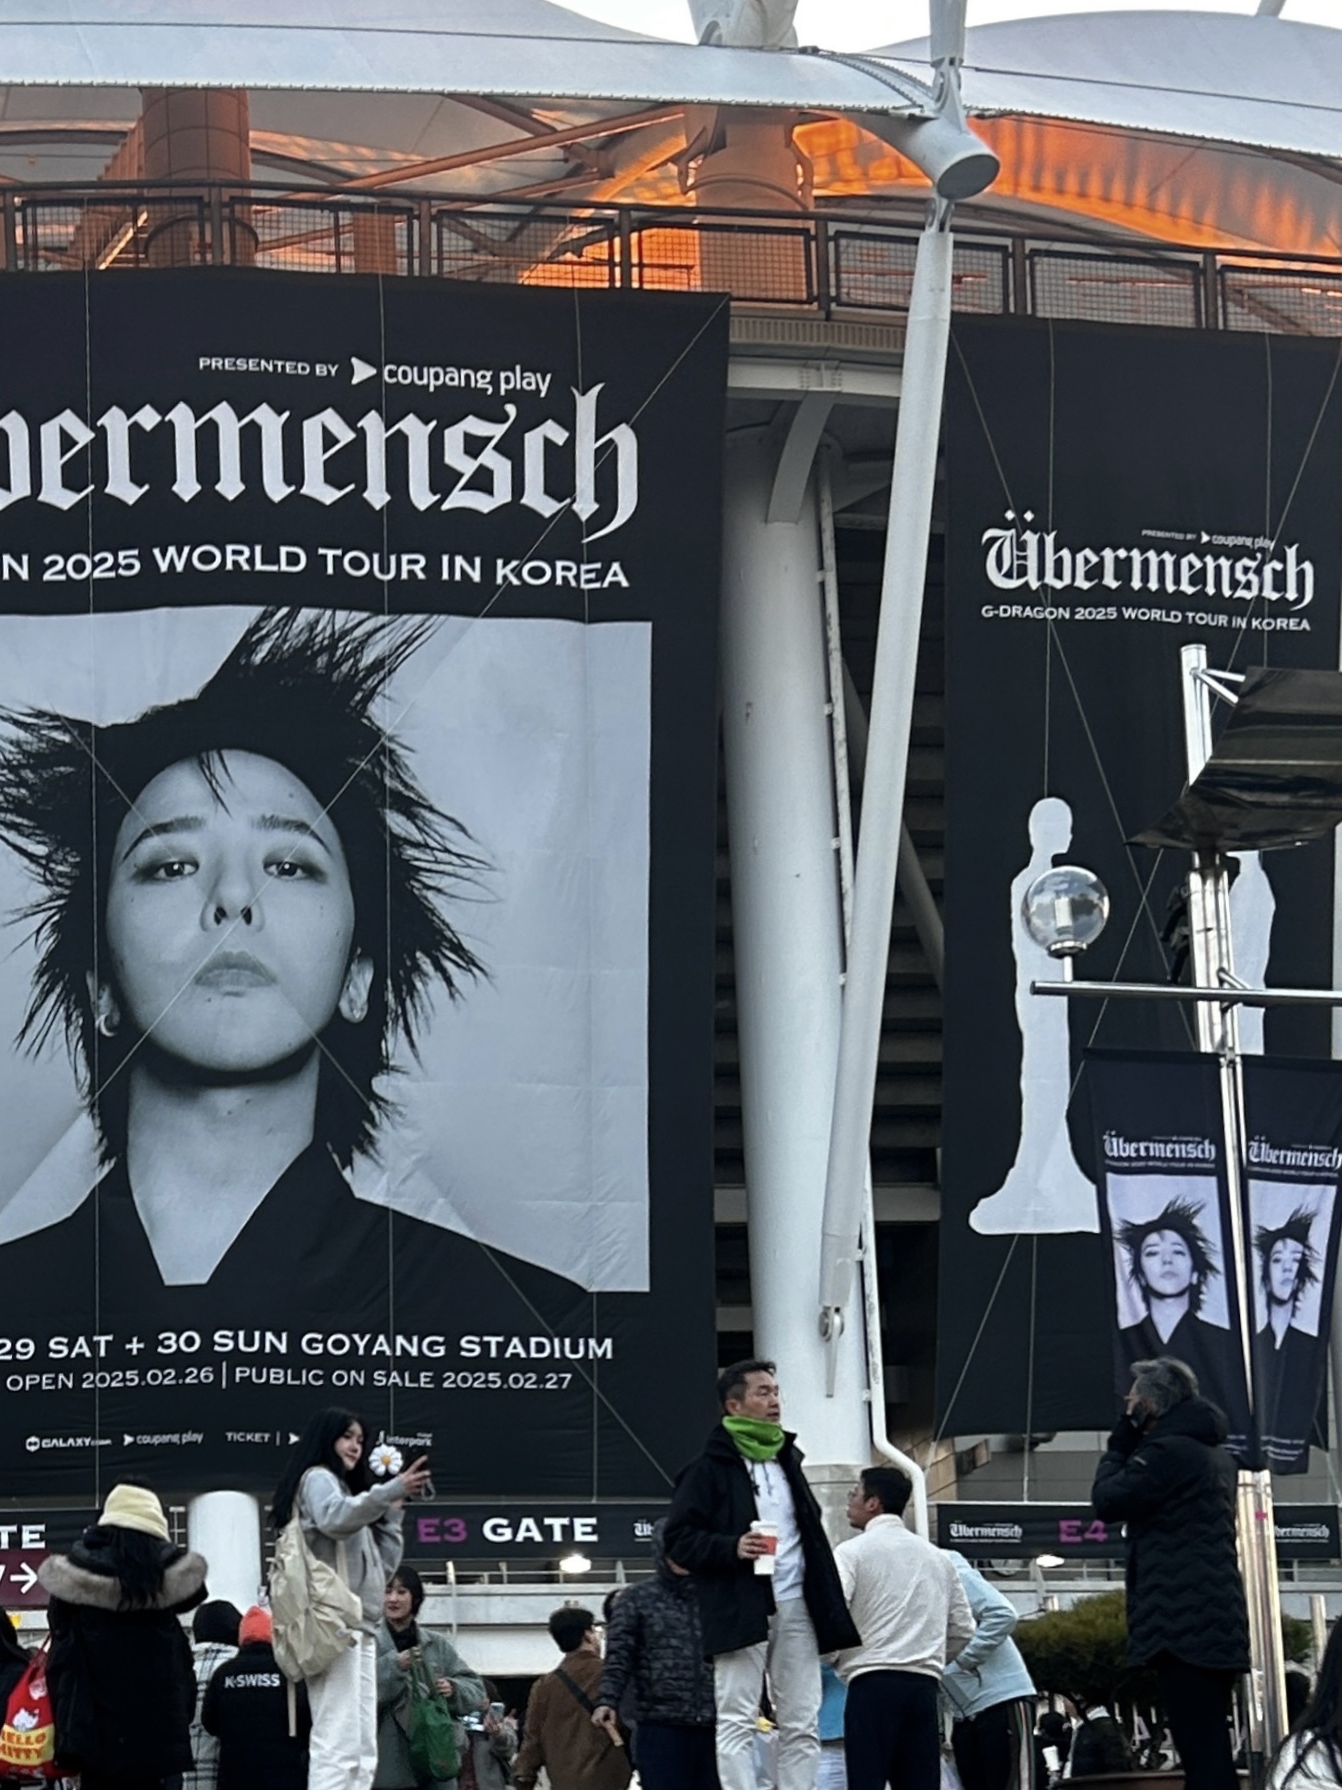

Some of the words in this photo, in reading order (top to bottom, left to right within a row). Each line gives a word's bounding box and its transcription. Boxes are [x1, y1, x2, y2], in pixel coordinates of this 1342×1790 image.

[200, 358, 310, 374] PRESENTED
[316, 364, 338, 376] BY
[384, 365, 492, 394] coupang
[500, 365, 551, 397] play
[43, 550, 140, 581] 2025
[153, 545, 306, 572] WORLD
[318, 548, 425, 580] TOUR
[442, 555, 480, 582] IN
[497, 559, 628, 589] KOREA
[981, 509, 1315, 611] Übermensch
[982, 606, 1069, 620] G-DRAGON
[1075, 607, 1117, 619] 2025
[1122, 607, 1182, 622] WORLD
[1186, 612, 1228, 626] TOUR
[1232, 617, 1247, 629] IN
[1252, 618, 1310, 630] KOREA
[49, 1335, 113, 1358] SAT
[126, 1337, 144, 1354] +
[158, 1331, 200, 1353] 30
[214, 1331, 286, 1353] SUN
[302, 1333, 445, 1357] GOYANG
[461, 1336, 611, 1358] STADIUM
[7, 1374, 73, 1390] OPEN
[82, 1367, 213, 1388] 2025.02.26
[236, 1367, 323, 1385] PUBLIC
[332, 1371, 364, 1385] ON
[374, 1371, 434, 1387] SALE
[443, 1372, 572, 1388] 2025.02.27
[225, 1432, 271, 1443] TICKET
[417, 1517, 468, 1543] E3
[482, 1516, 599, 1543] GATE
[1058, 1519, 1108, 1543] E4
